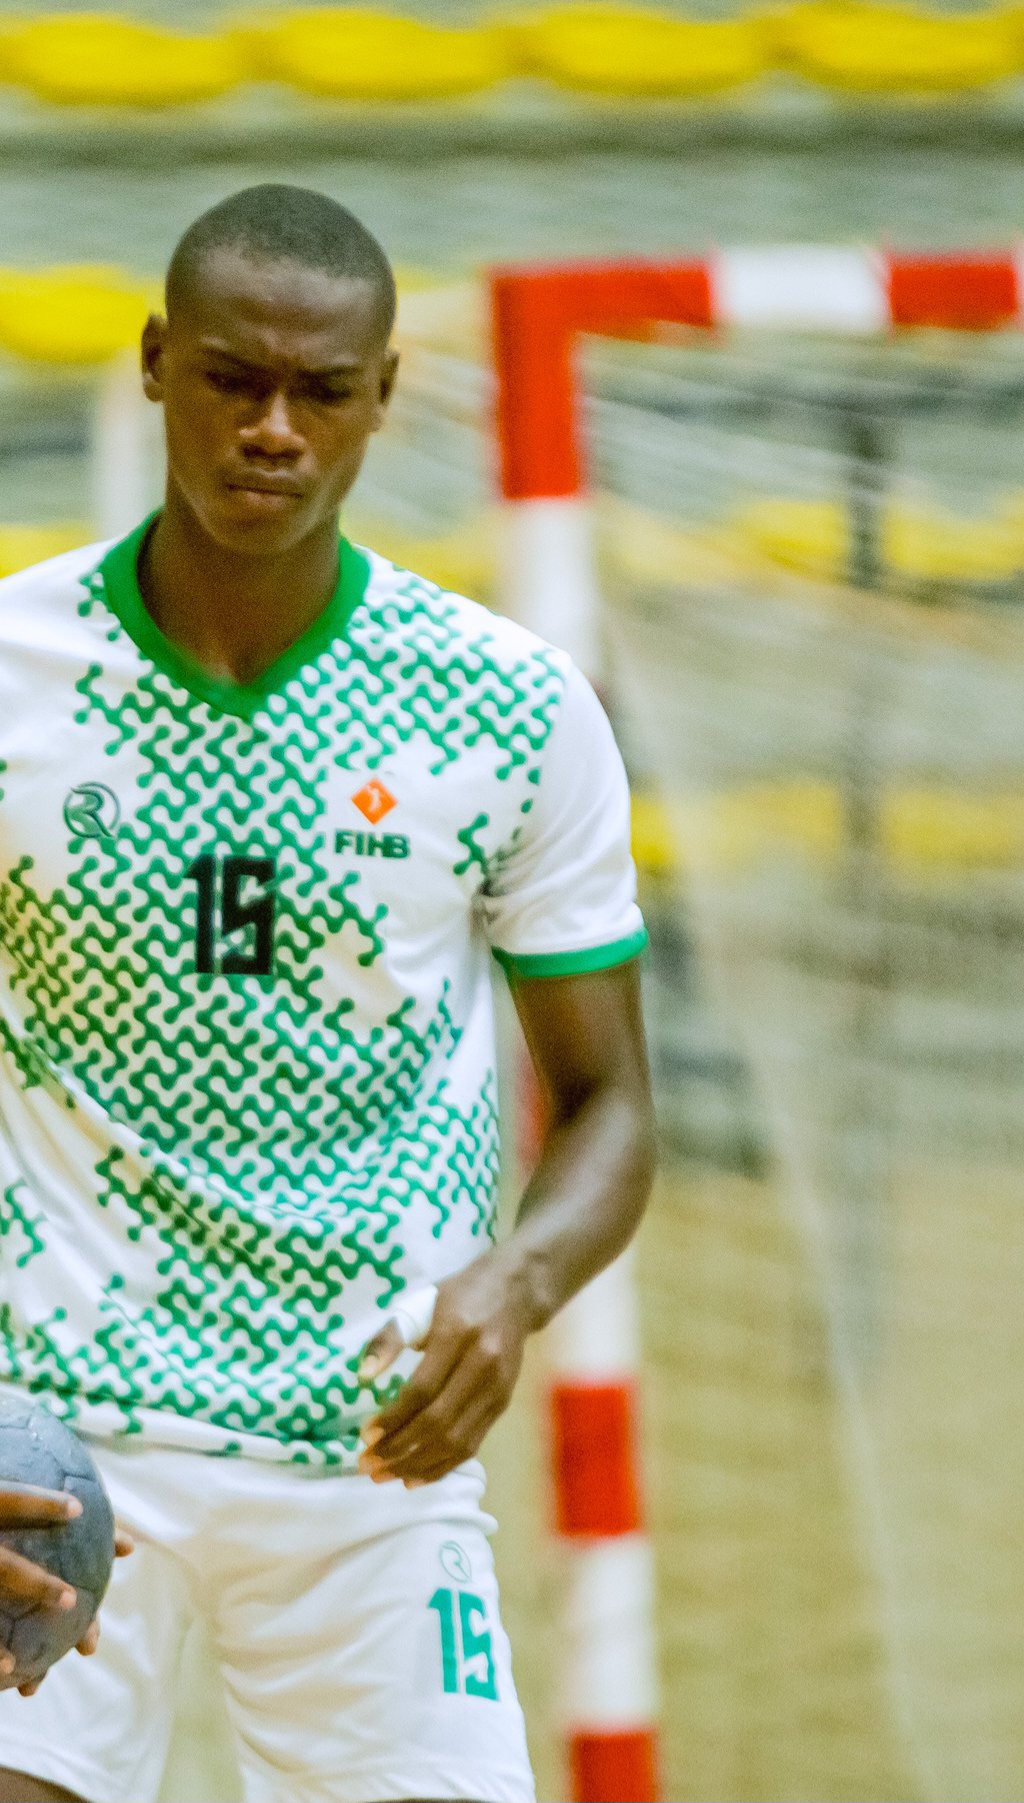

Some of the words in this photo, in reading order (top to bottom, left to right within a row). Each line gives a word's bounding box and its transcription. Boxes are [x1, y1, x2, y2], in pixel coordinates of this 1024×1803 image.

[334, 828, 410, 859] FIHB
[183, 854, 275, 975] 15
[427, 1587, 499, 1701] 15
